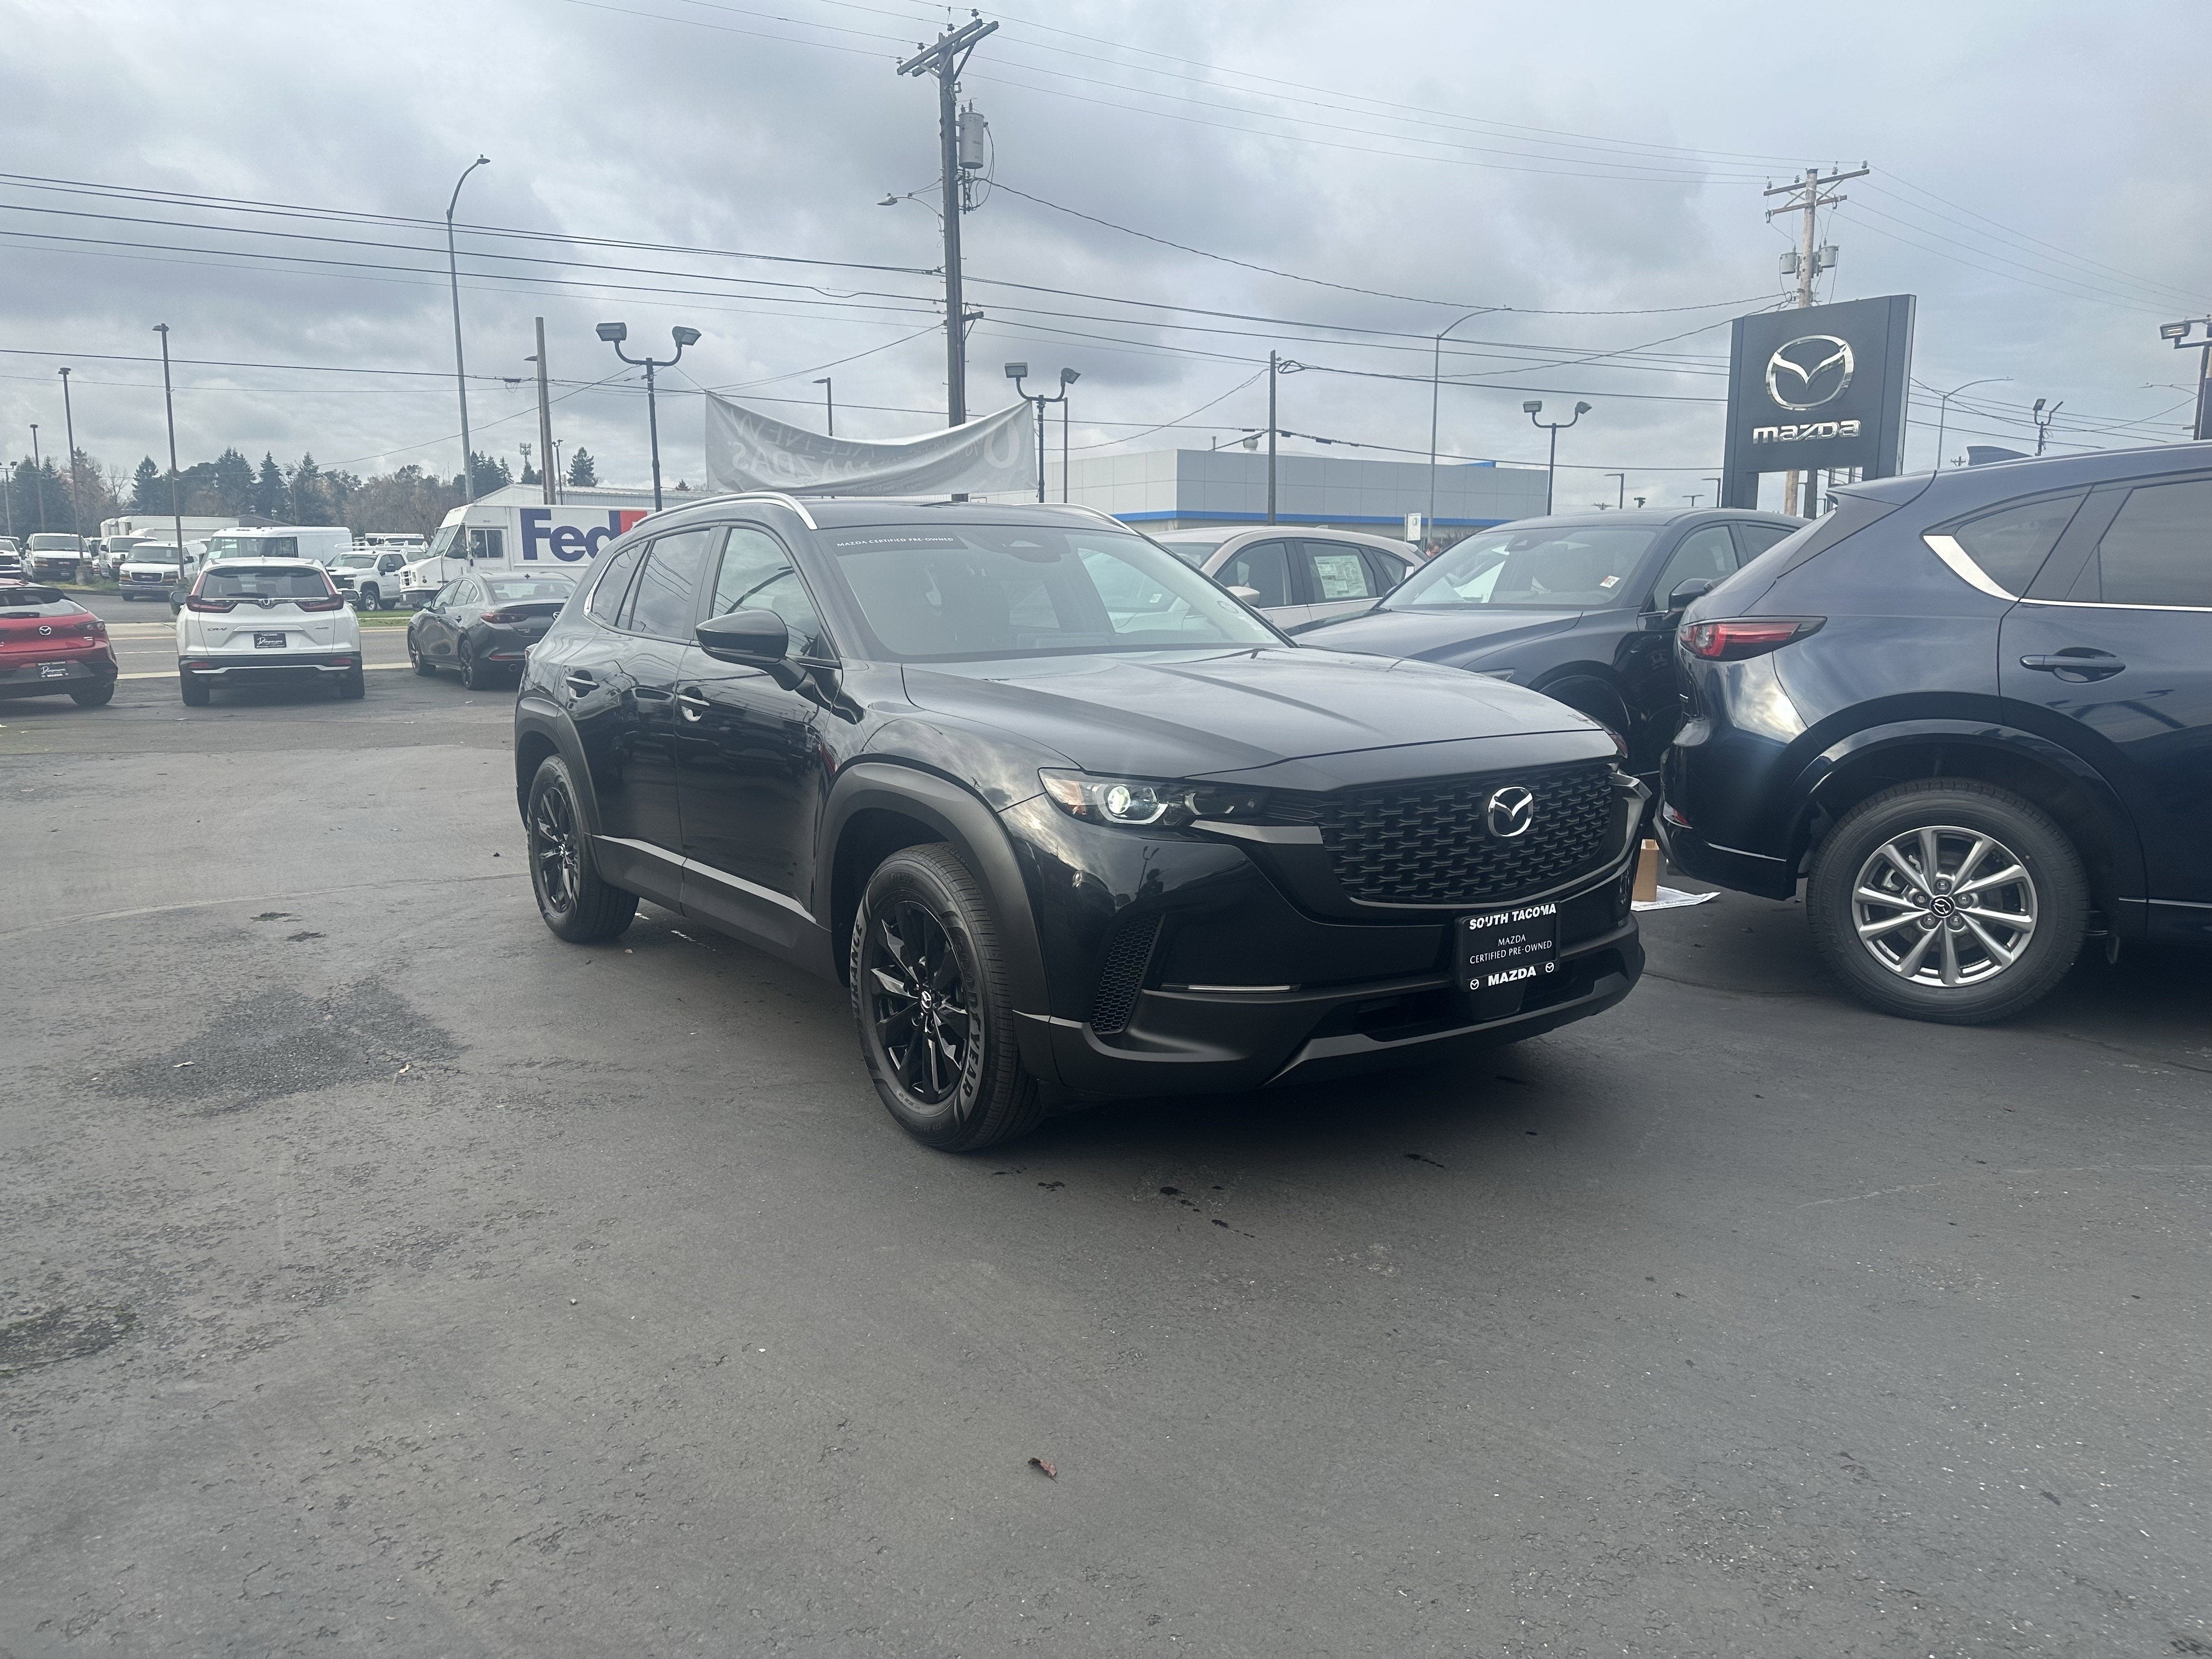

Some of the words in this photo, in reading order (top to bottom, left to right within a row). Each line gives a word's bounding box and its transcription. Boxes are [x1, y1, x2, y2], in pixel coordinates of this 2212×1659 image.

[1752, 420, 1861, 444] mazda
[1469, 912, 1509, 930] SOUTH
[1511, 903, 1556, 922] TACOMA
[1470, 950, 1506, 964] CERTIFIED
[1509, 940, 1552, 956] PRE-OWNED
[1498, 934, 1526, 946] MAZDA
[1488, 966, 1537, 986] MAZDA
